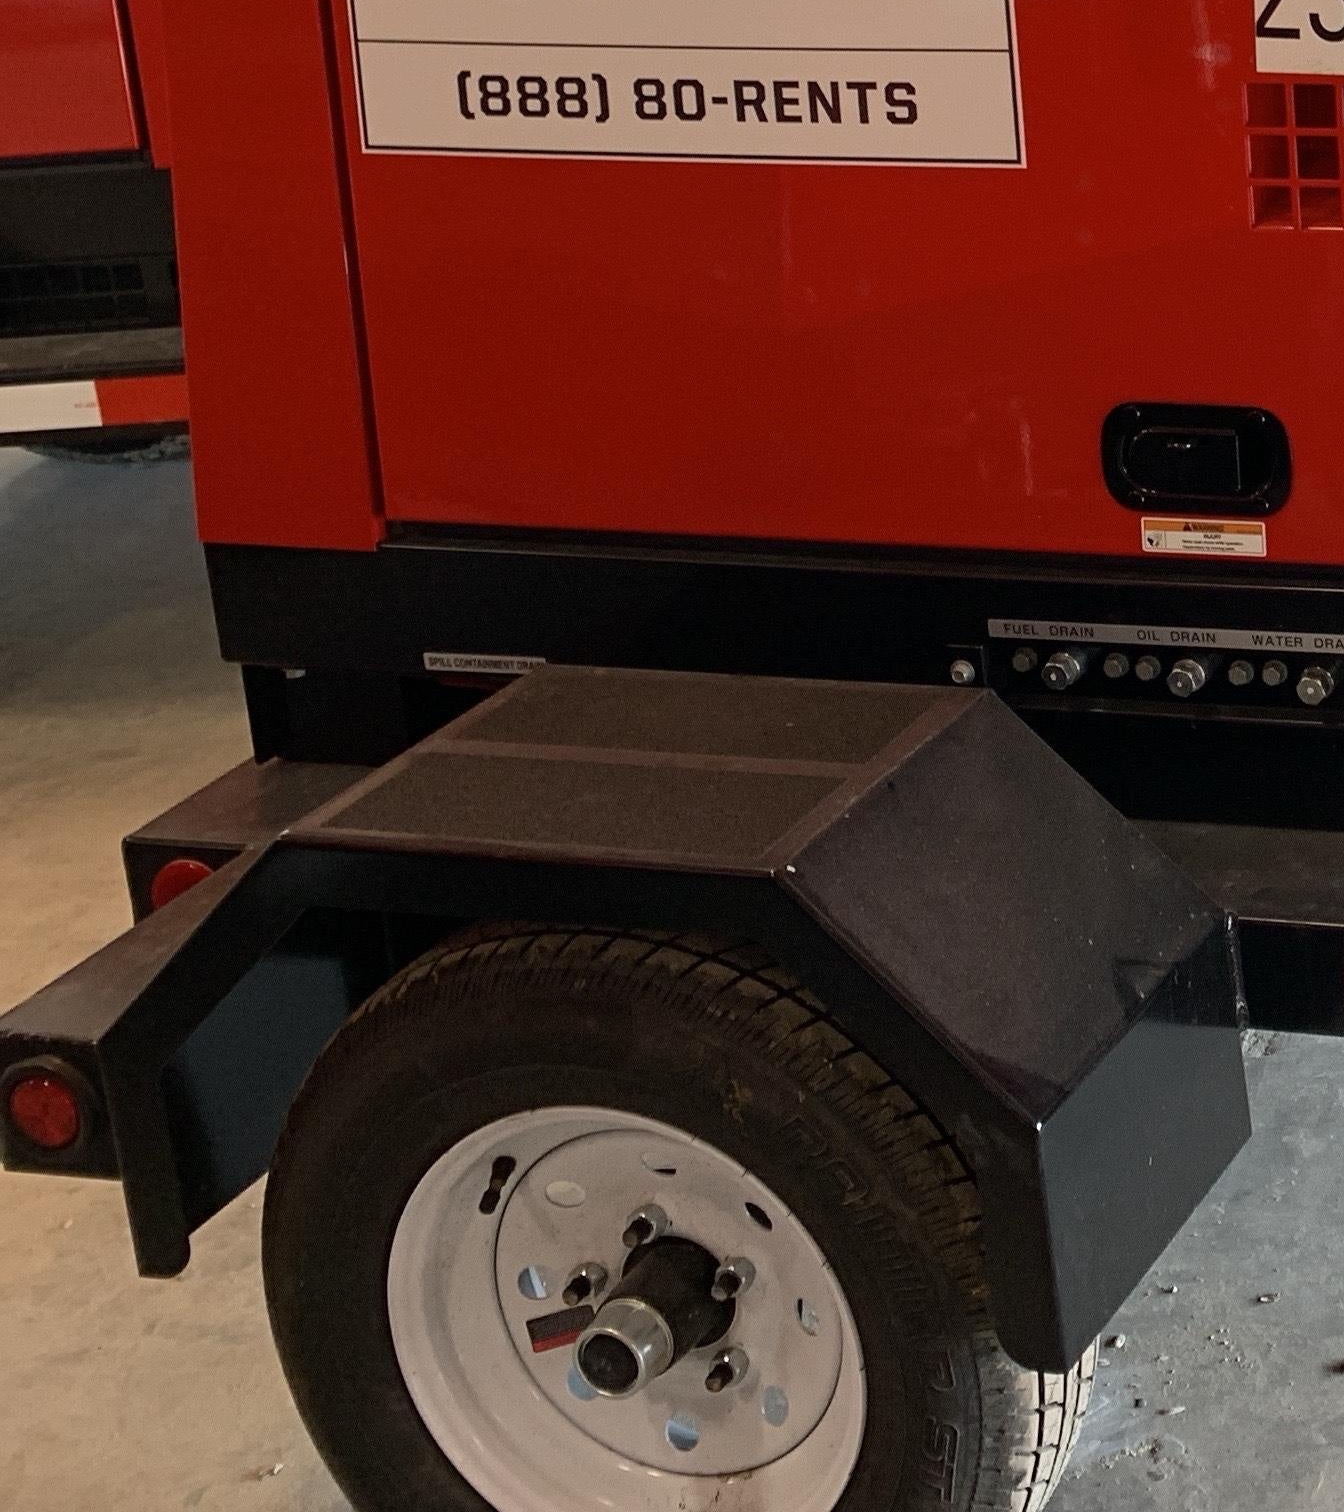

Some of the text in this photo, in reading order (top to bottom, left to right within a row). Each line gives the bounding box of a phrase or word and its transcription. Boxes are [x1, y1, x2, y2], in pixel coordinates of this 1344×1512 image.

[455, 70, 919, 126] (888) 80-RENTS
[1003, 623, 1096, 639] FUEL DRAIN
[1136, 629, 1217, 644] OIL DRAIN
[1251, 634, 1304, 648] WATER
